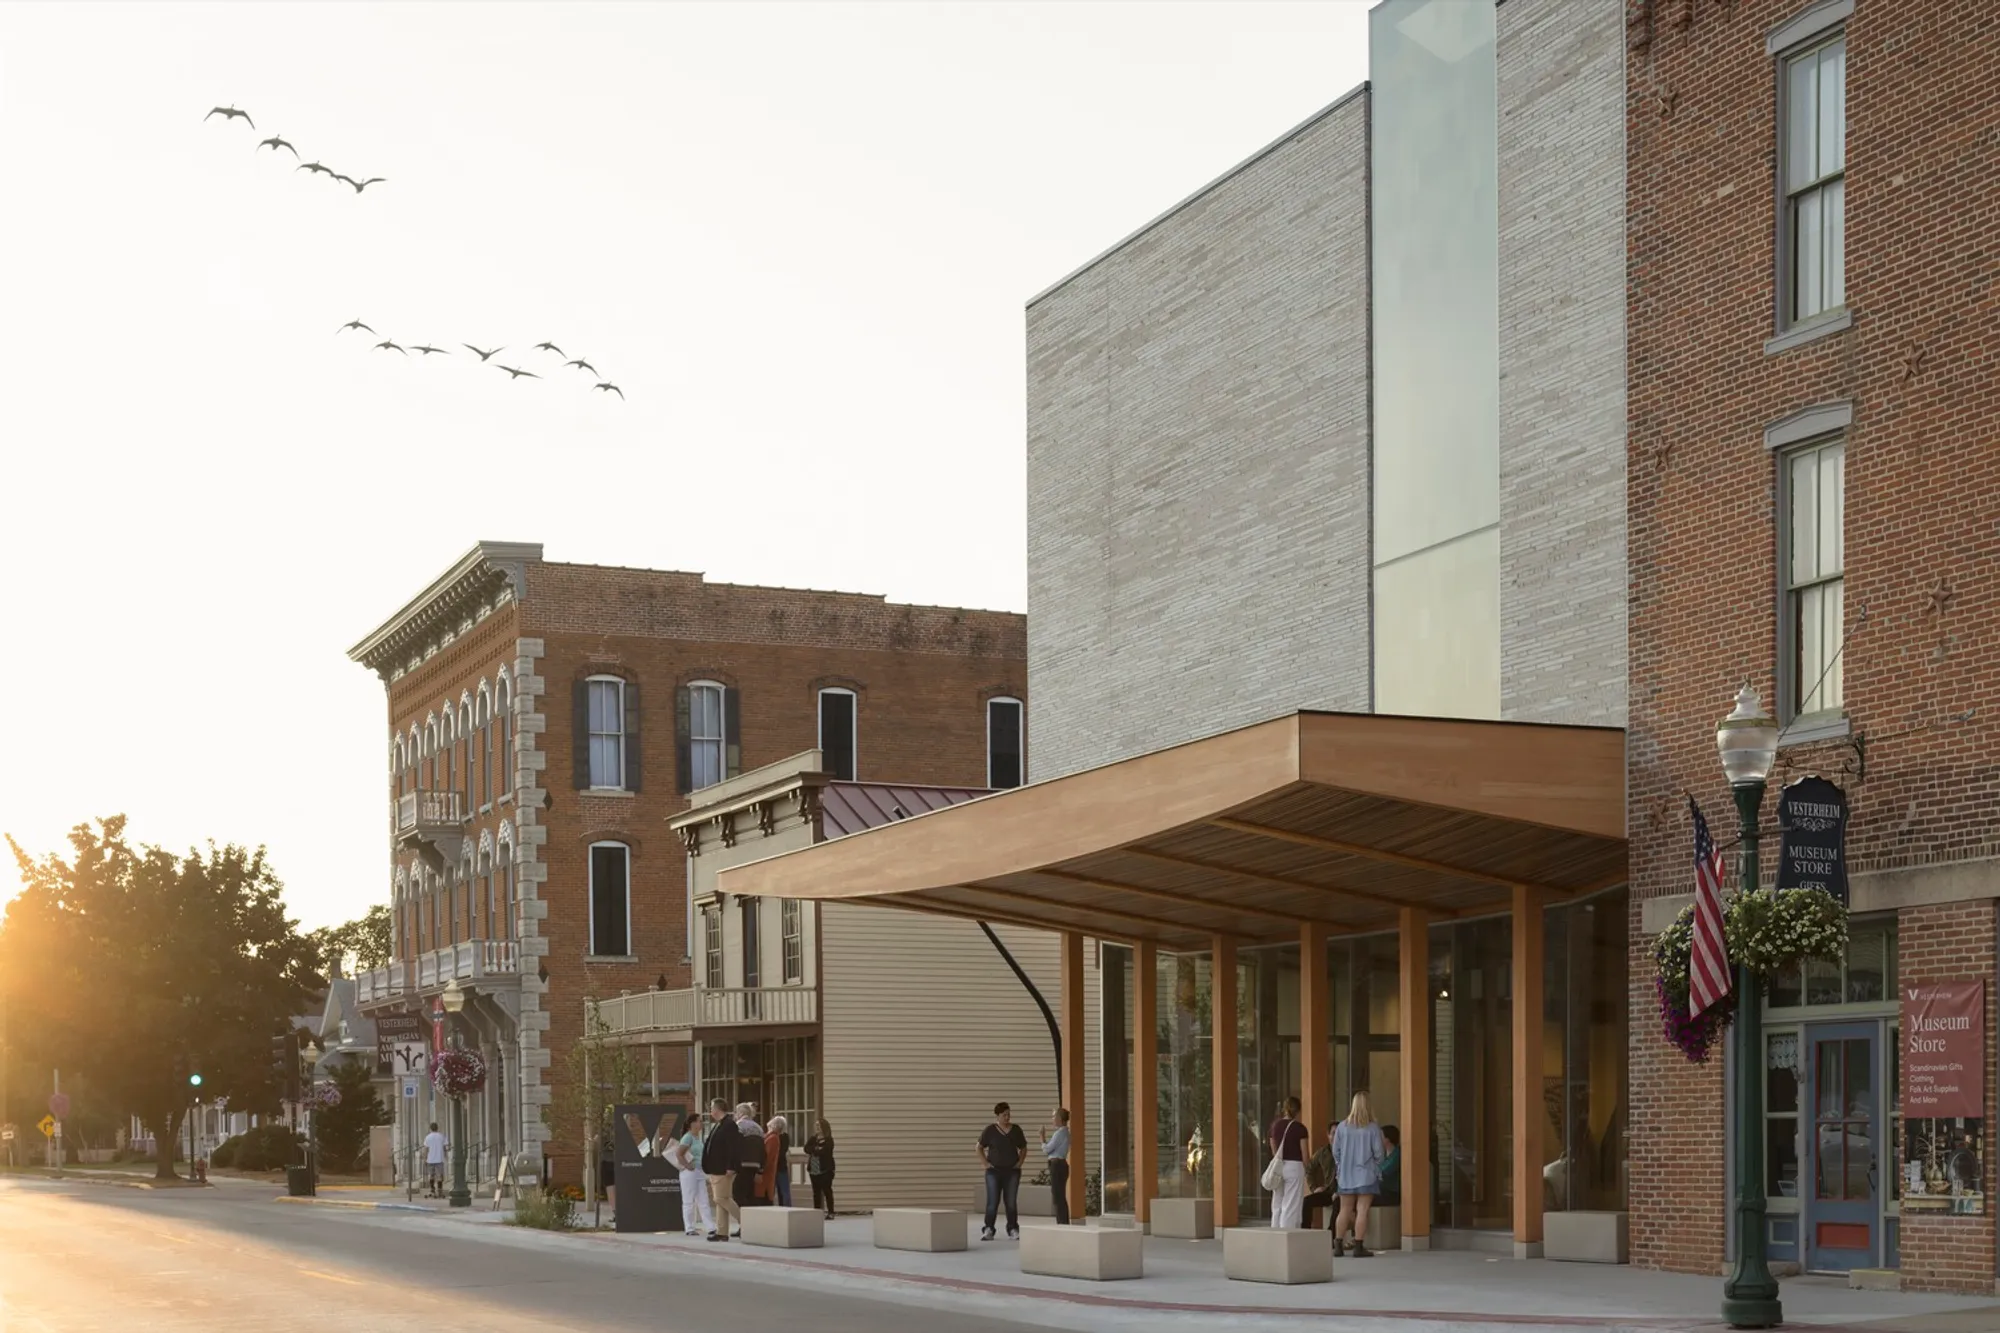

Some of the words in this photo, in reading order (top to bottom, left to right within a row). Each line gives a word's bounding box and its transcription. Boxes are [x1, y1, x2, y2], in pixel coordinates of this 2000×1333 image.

[1788, 801, 1840, 819] VESTERHEIM
[1789, 845, 1838, 861] MUSEUM
[1794, 861, 1832, 875] STORE
[1910, 1014, 1970, 1032] Museum
[1910, 1034, 1946, 1053] Store
[1909, 1064, 1948, 1072] Scandinavian
[1948, 1062, 1963, 1071] Gifts
[1909, 1074, 1935, 1084] Clothing
[1909, 1085, 1921, 1093] Folk
[1923, 1085, 1933, 1093] Art
[1933, 1084, 1959, 1094] Supplies
[1909, 1096, 1921, 1104] And
[1922, 1096, 1938, 1104] More
